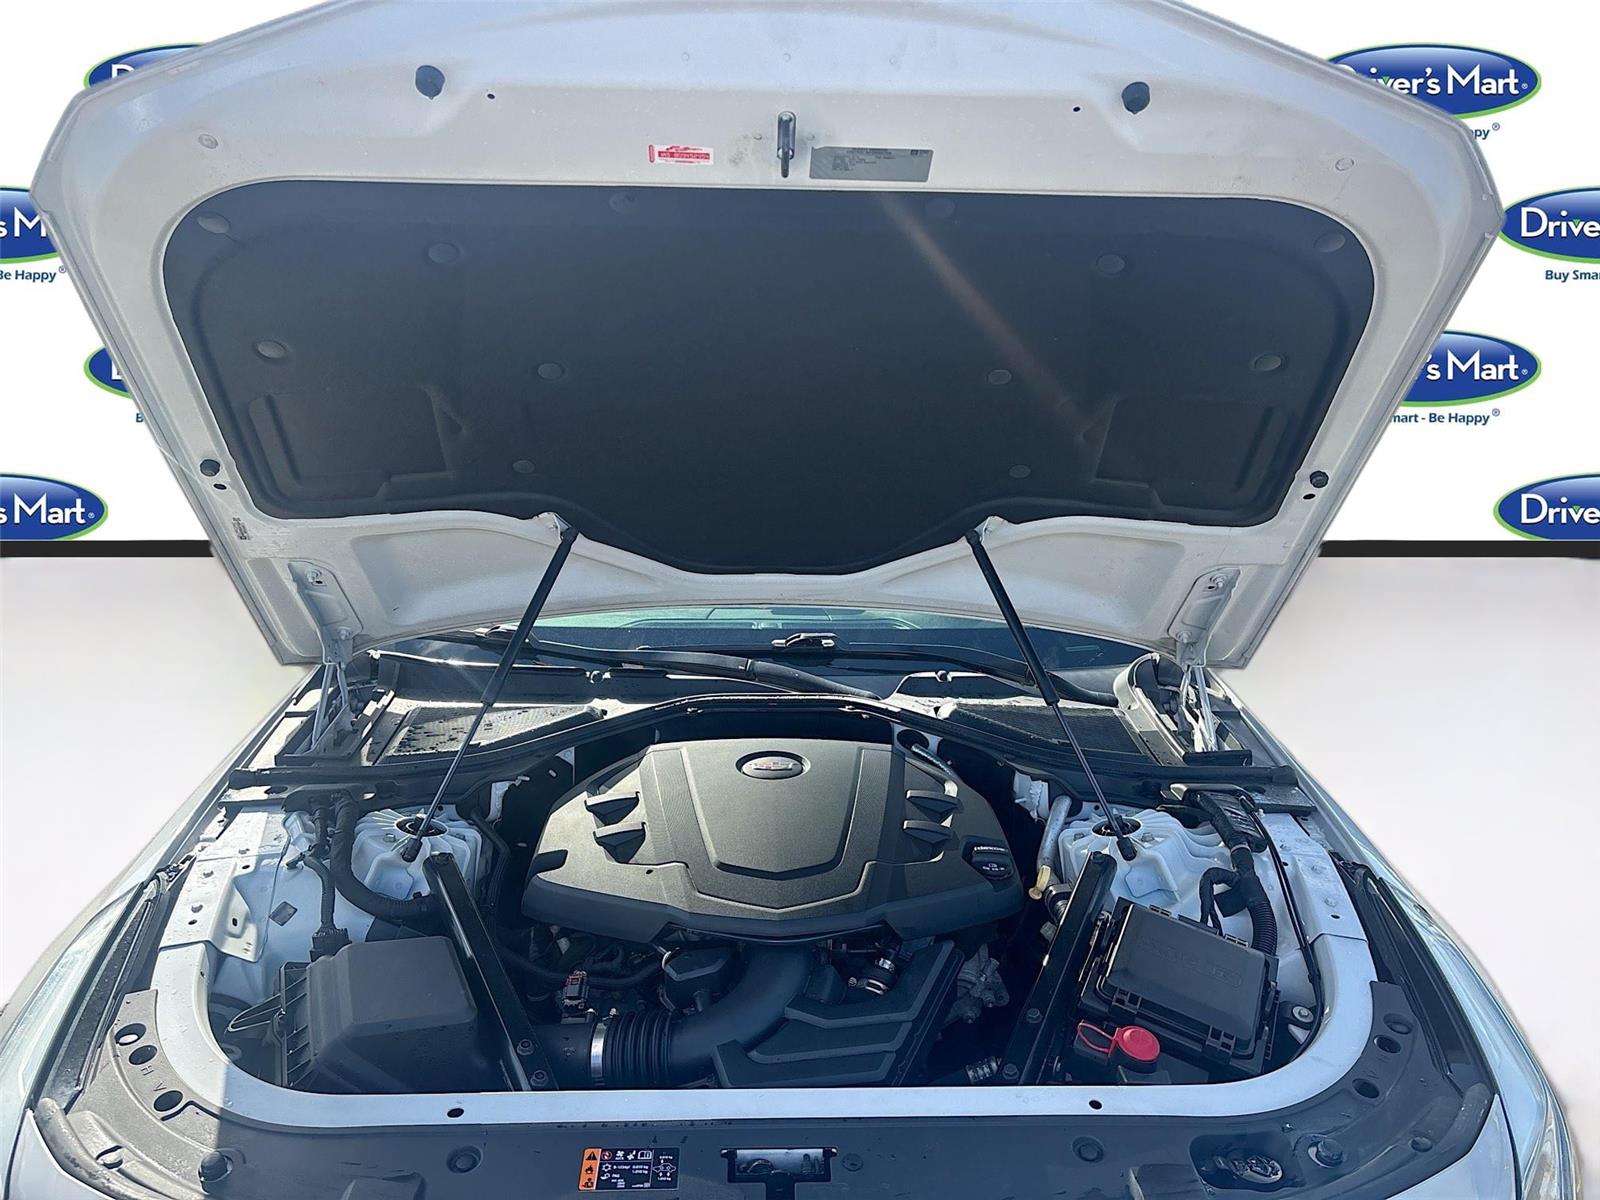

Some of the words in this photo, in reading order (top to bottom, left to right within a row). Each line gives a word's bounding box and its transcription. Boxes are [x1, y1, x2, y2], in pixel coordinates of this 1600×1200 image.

[1337, 64, 1441, 96] iver's
[1447, 64, 1519, 96] Mart
[1471, 128, 1490, 140] py
[1521, 206, 1600, 238] Drive
[15, 269, 57, 283] Happy
[1545, 269, 1570, 283] Buy
[1447, 349, 1519, 381] Mart
[1429, 412, 1445, 424] Be
[1448, 412, 1490, 426] Happy
[14, 493, 86, 524] Mart
[1521, 493, 1600, 525] Drive
